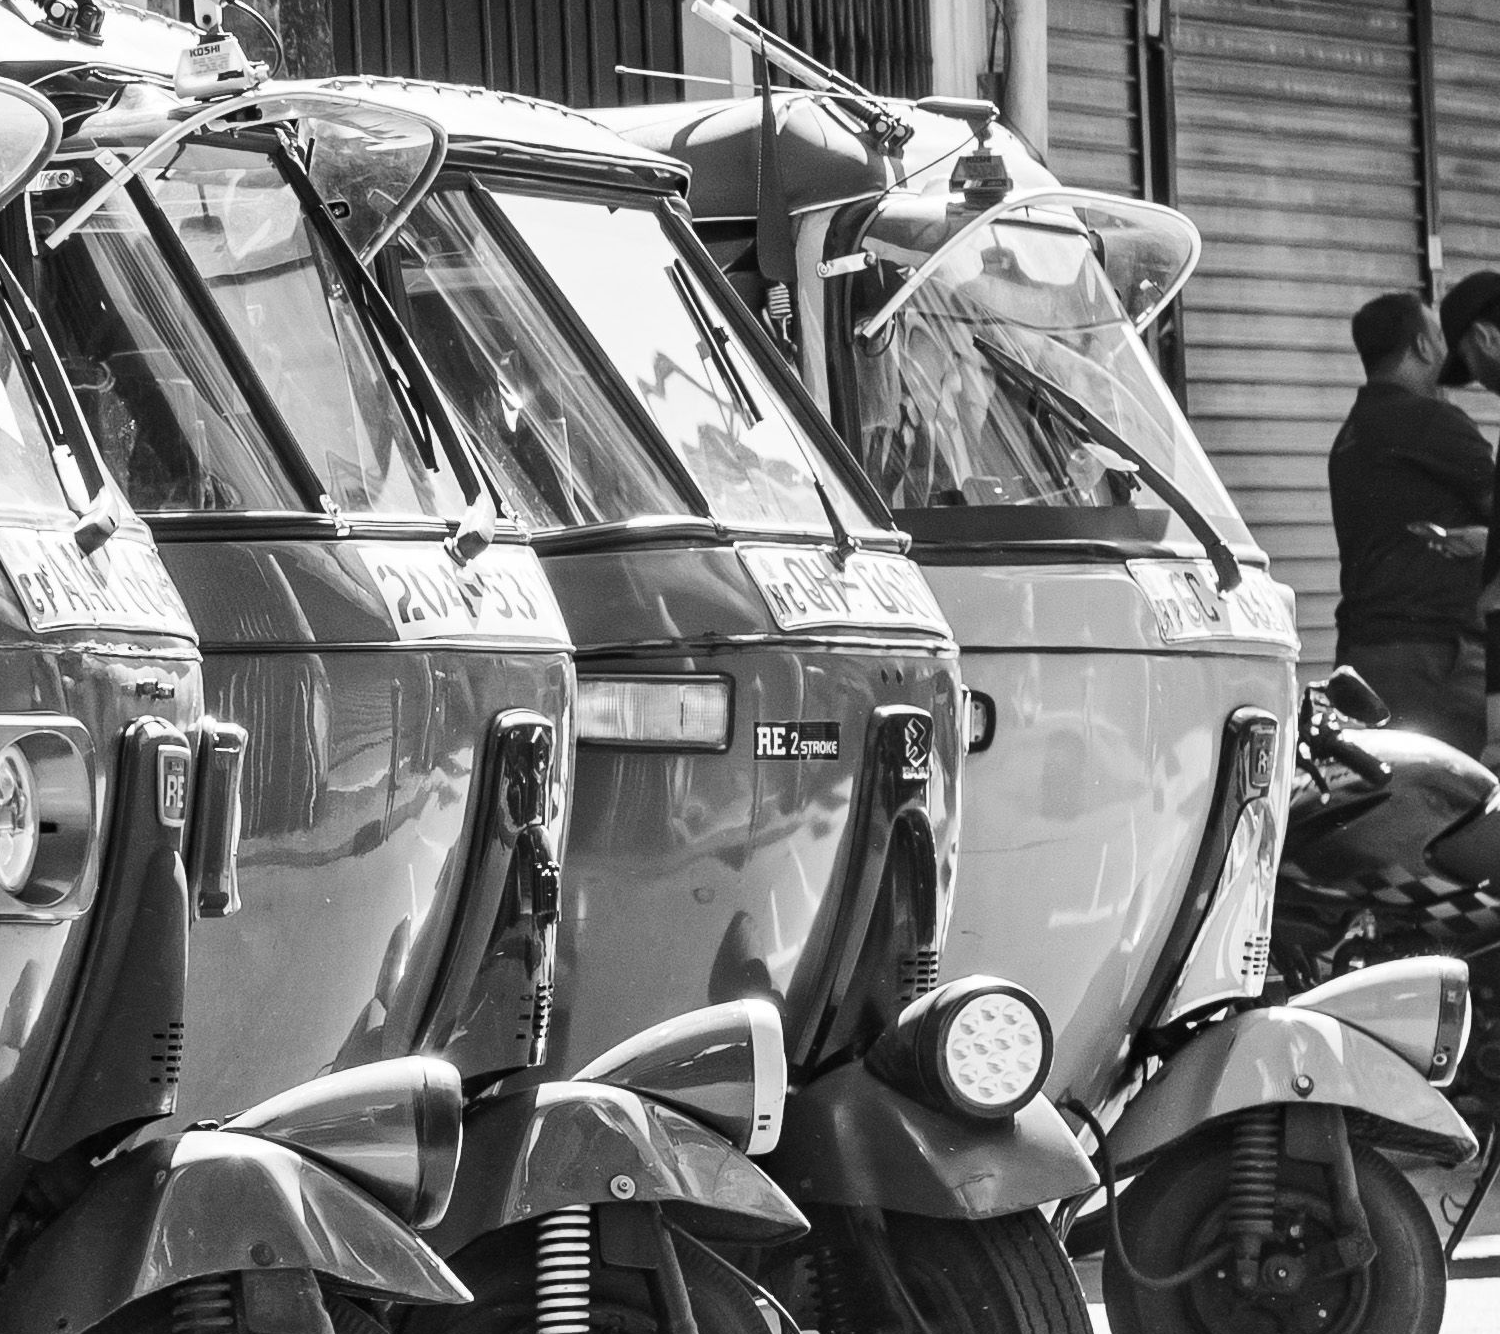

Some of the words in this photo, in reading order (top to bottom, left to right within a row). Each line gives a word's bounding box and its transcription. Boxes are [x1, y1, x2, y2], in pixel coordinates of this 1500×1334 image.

[189, 44, 221, 58] KOSHI
[756, 726, 787, 756] RE
[790, 731, 800, 755] 2
[800, 739, 838, 755] STROKE
[165, 774, 186, 809] RE
